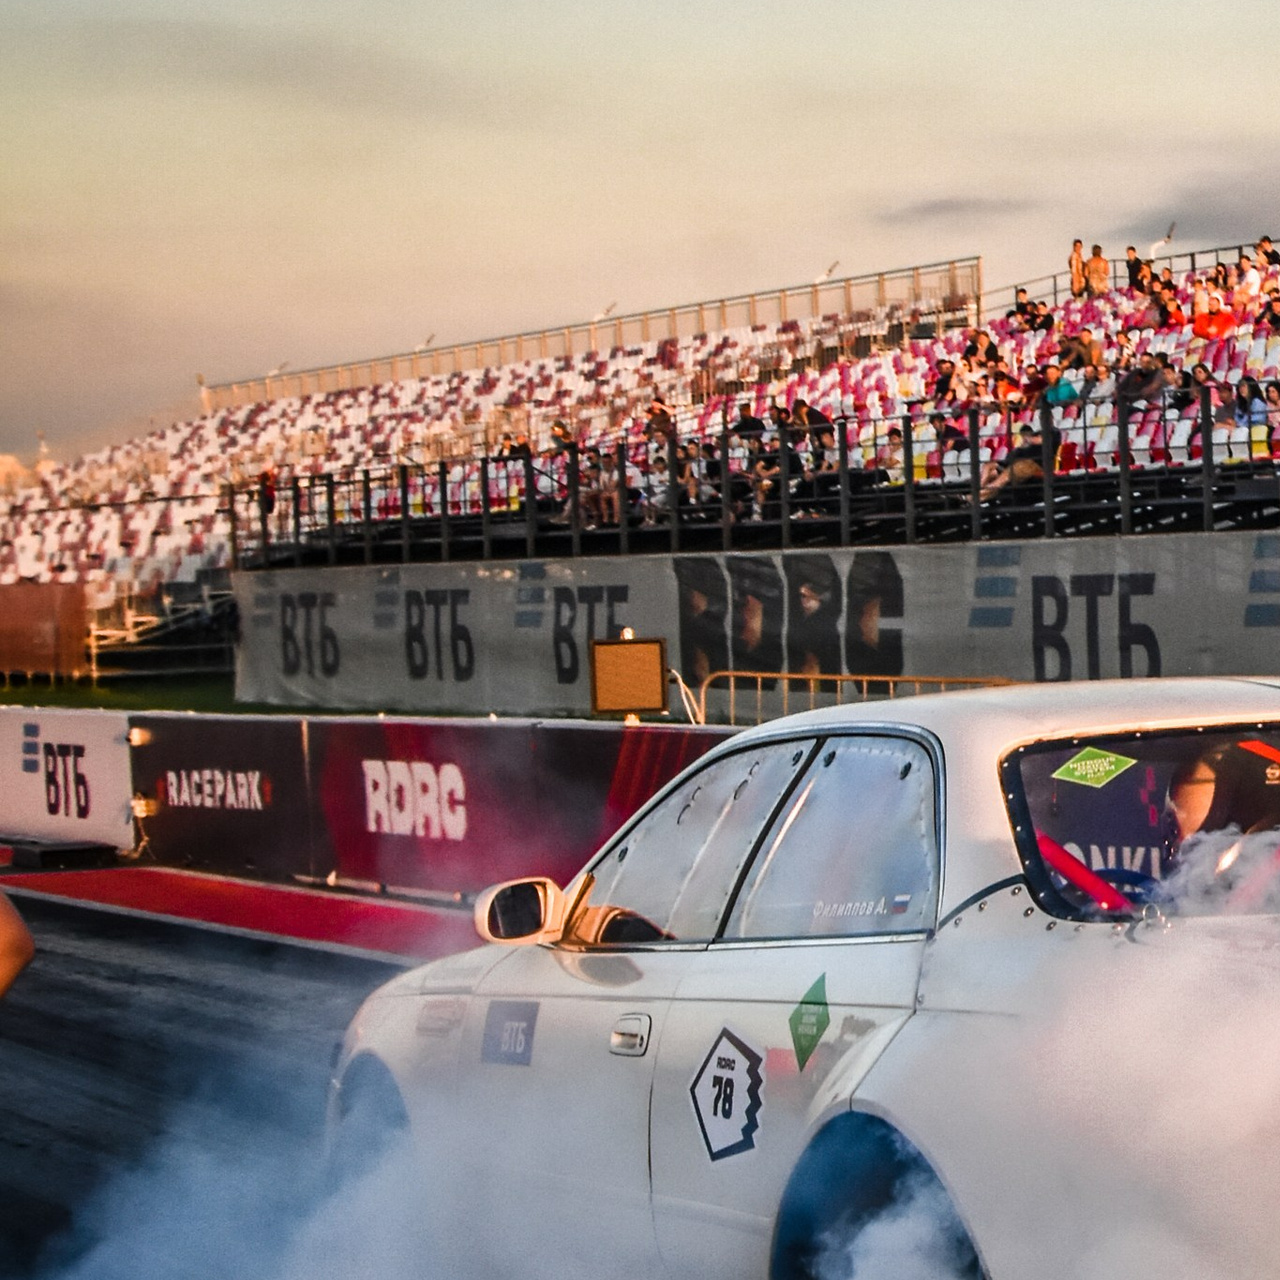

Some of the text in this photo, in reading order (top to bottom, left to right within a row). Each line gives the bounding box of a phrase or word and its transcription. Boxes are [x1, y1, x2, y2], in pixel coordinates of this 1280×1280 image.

[280, 592, 340, 678] ВТБ
[405, 589, 474, 682] ВТБ
[1032, 572, 1161, 682] ВТБ
[43, 742, 90, 819] ВТБ
[166, 769, 263, 810] RACEPARK
[362, 758, 468, 842] RDRC
[813, 900, 875, 918] Филиппов
[501, 1021, 528, 1053] ВТБ
[712, 1075, 734, 1119] 78
